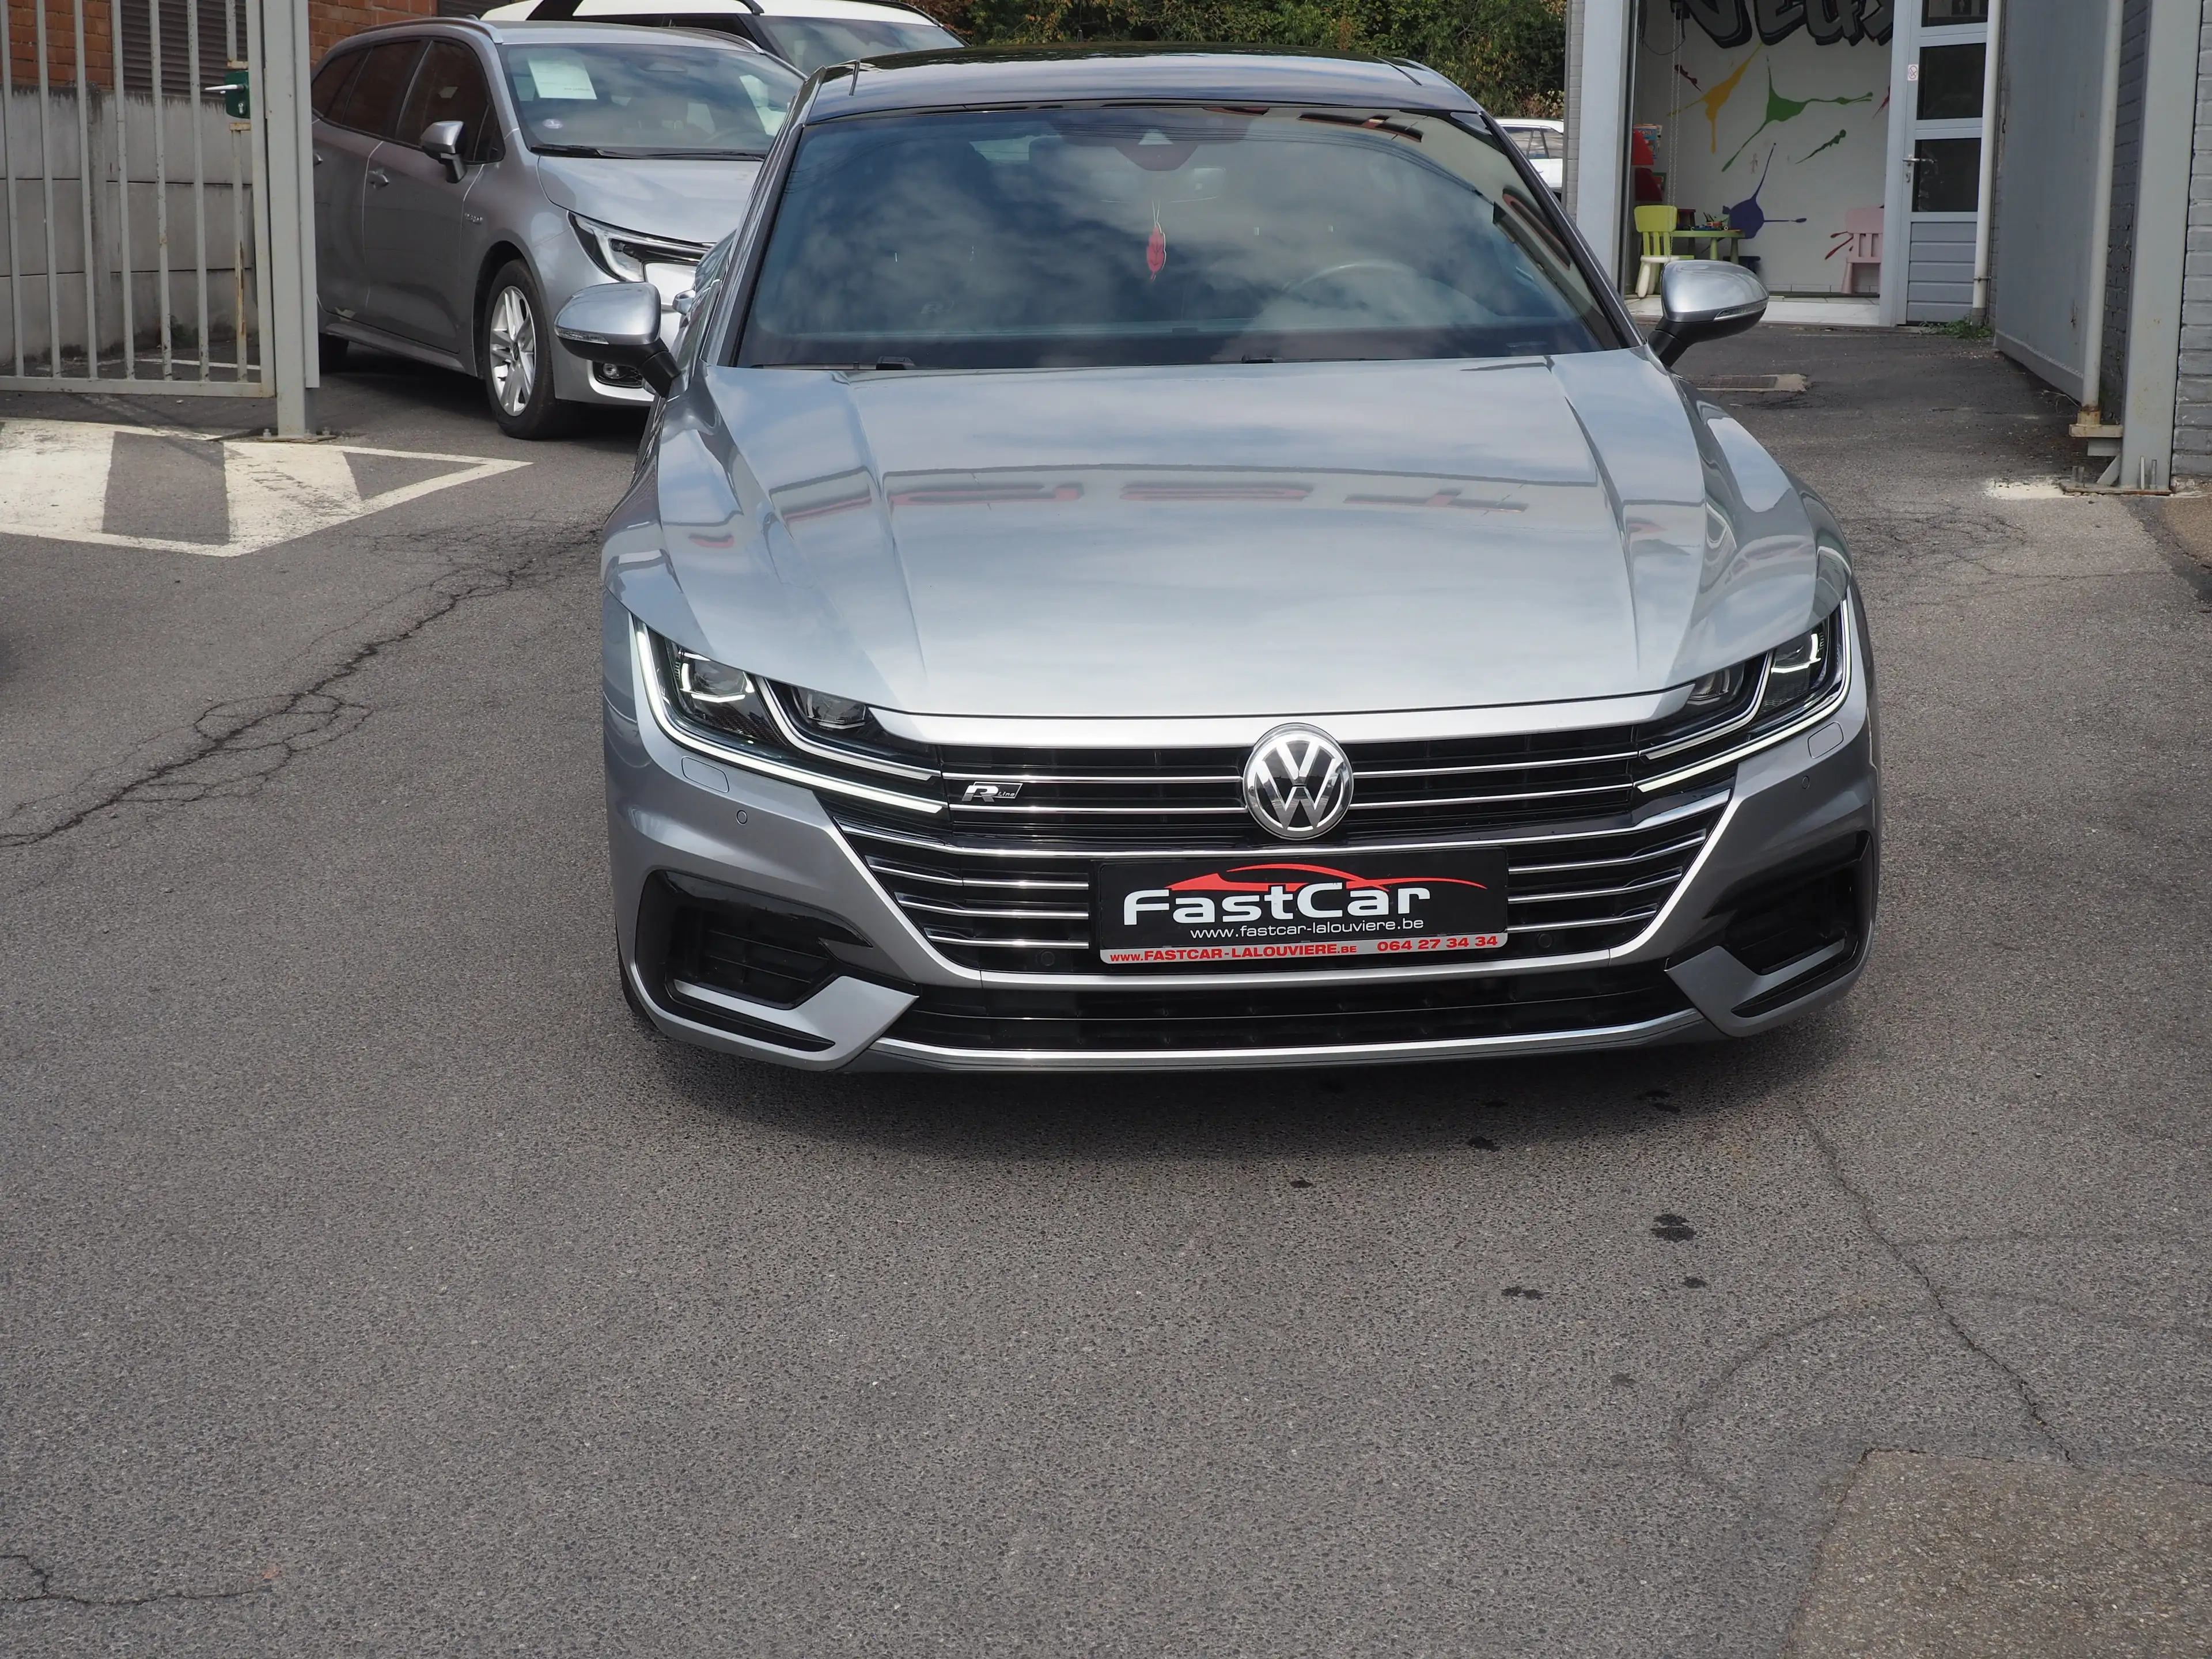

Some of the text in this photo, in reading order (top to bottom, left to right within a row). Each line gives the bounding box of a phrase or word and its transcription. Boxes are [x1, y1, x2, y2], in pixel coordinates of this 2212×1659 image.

[1248, 728, 1349, 836] VW
[1123, 881, 1431, 926] FastCar
[1190, 918, 1425, 939] www.fastcar-lalouviere.be
[1377, 940, 1412, 952] 064
[1418, 939, 1441, 950] 27
[1446, 937, 1469, 949] 34
[1474, 935, 1498, 947] 34
